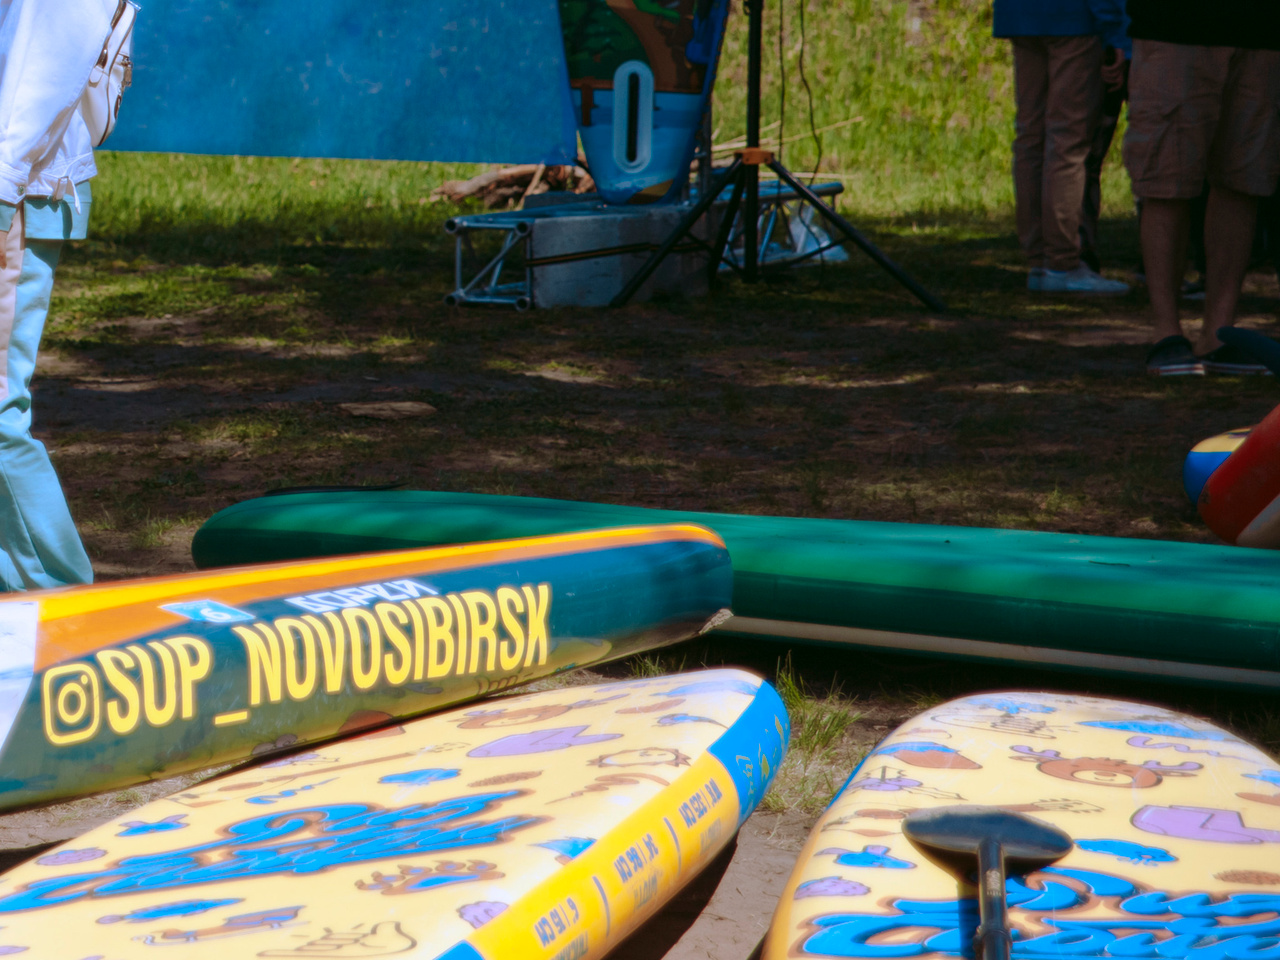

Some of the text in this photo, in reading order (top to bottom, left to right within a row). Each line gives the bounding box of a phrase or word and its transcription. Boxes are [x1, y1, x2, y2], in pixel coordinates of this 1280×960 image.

[98, 584, 550, 734] SUP_NOVOSIBIRSK
[678, 802, 697, 829] CM
[613, 855, 633, 883] CM
[533, 916, 556, 948] CM
